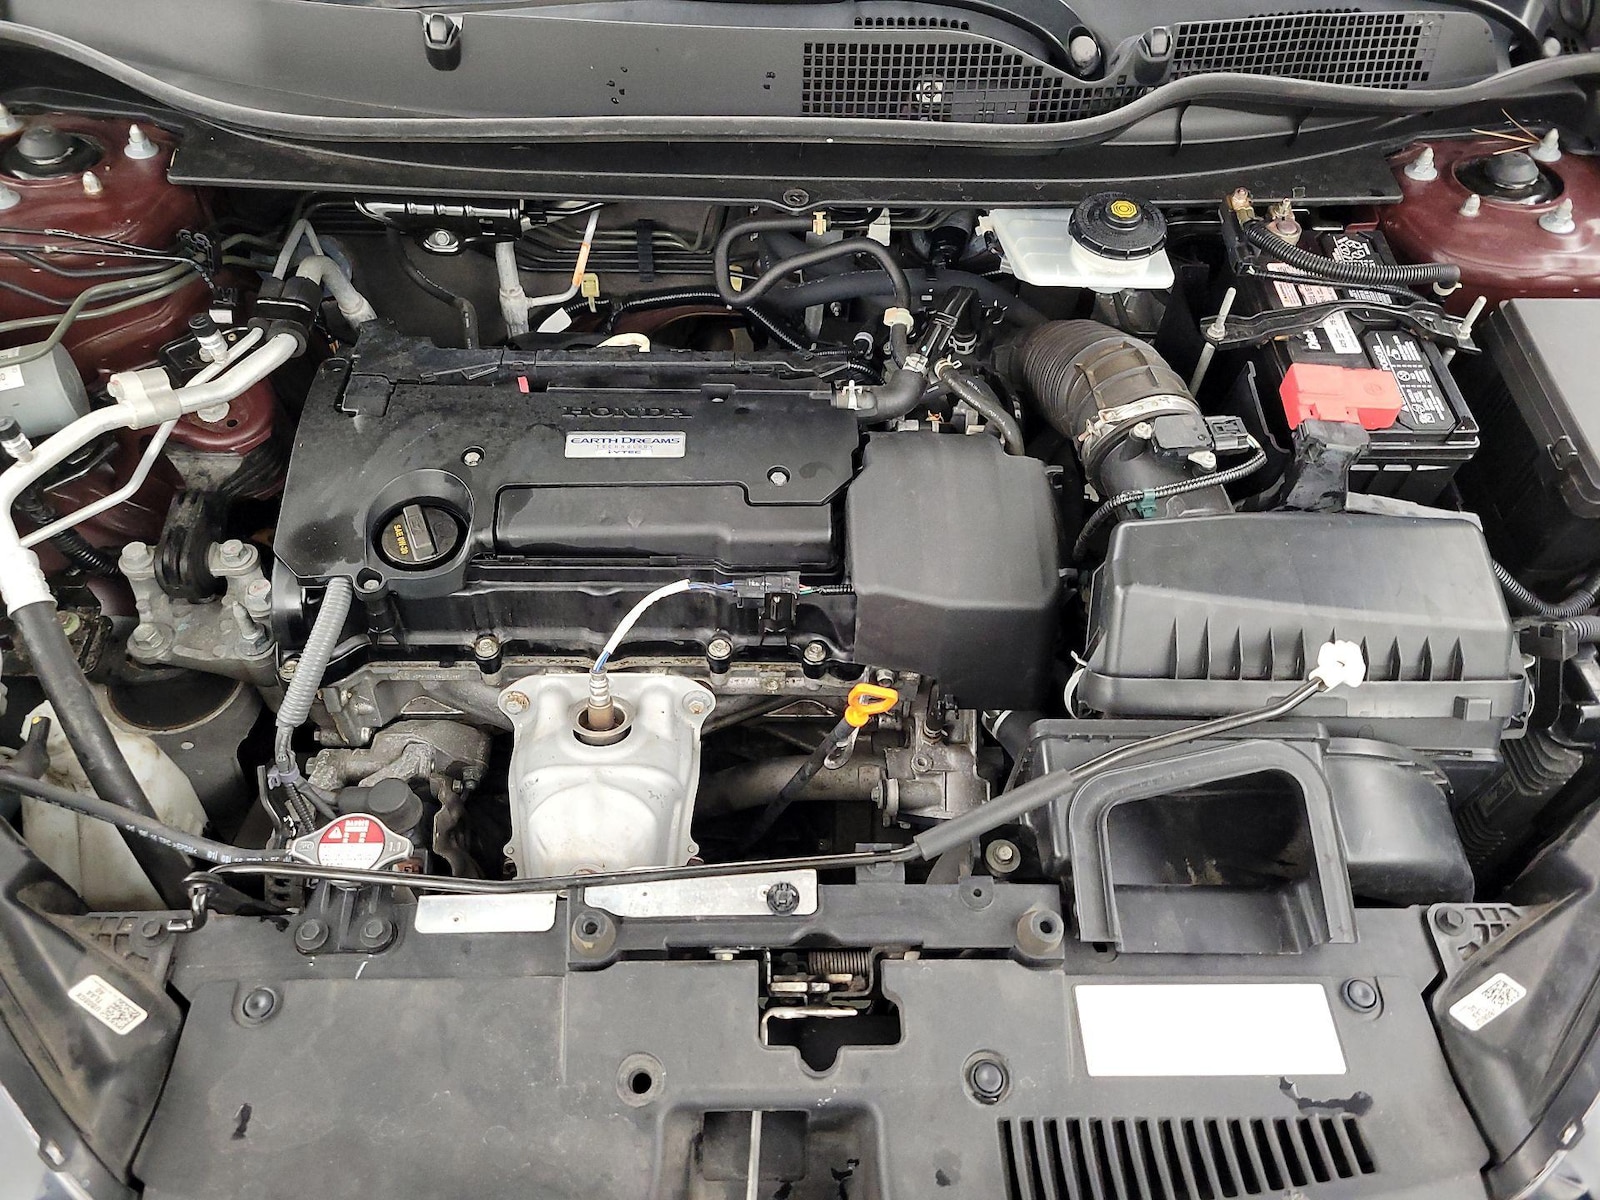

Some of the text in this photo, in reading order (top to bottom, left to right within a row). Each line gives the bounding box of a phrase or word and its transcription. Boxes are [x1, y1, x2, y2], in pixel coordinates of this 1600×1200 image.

[1373, 345, 1391, 371] POISON
[561, 407, 693, 419] HONDA
[621, 436, 680, 444] DREAMS
[393, 524, 409, 555] SAE 0W-20
[389, 841, 402, 852] 1.1
